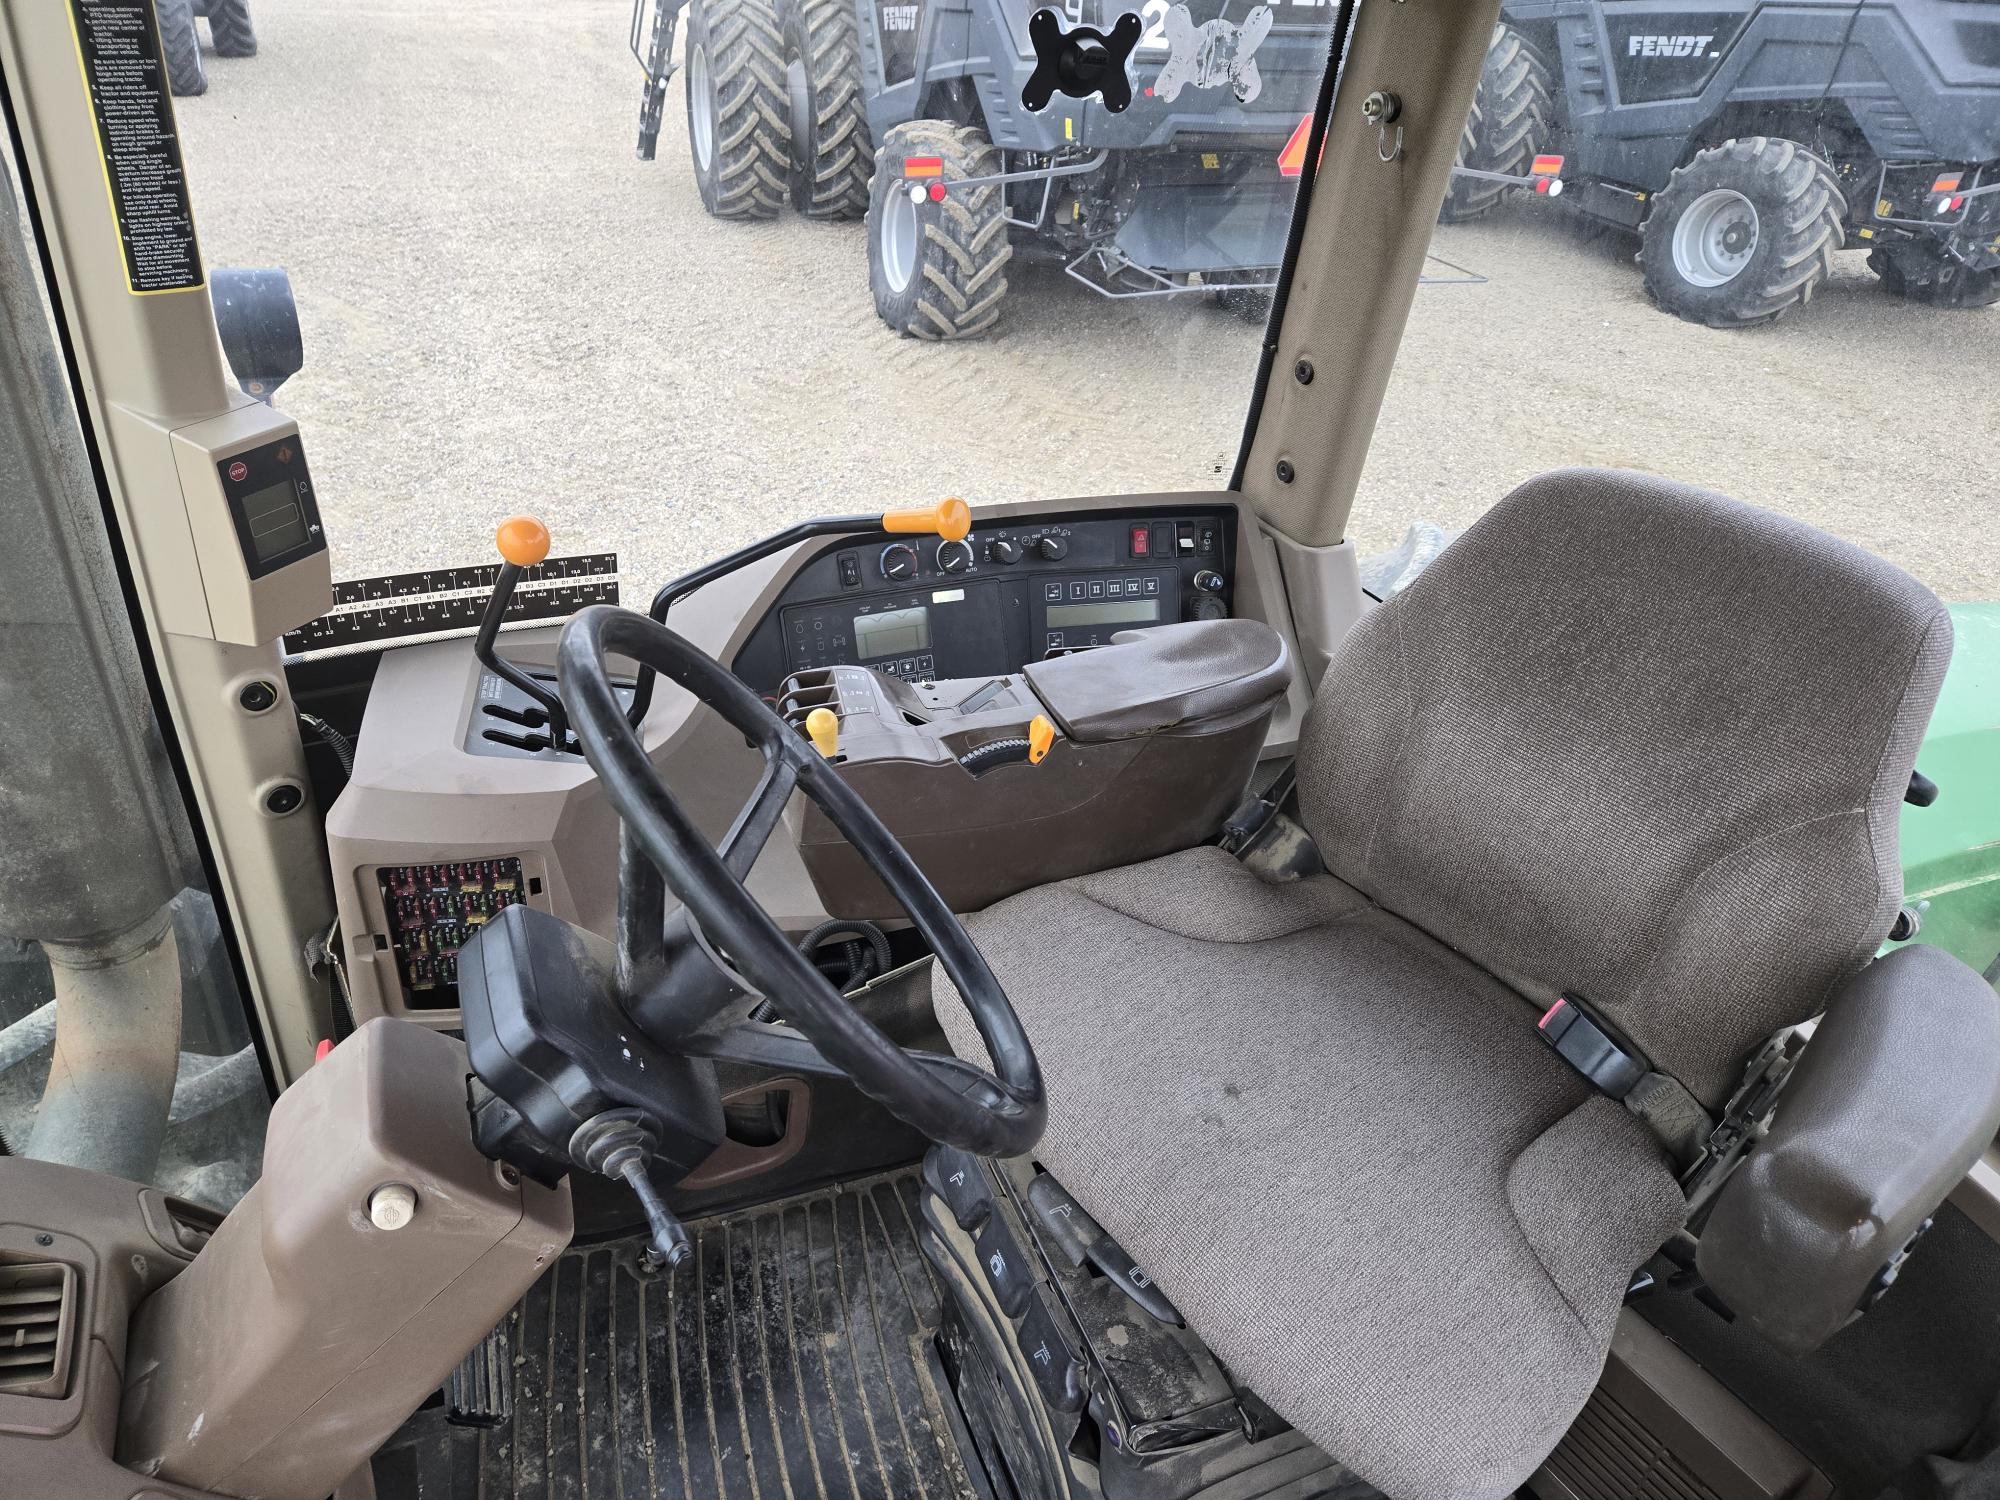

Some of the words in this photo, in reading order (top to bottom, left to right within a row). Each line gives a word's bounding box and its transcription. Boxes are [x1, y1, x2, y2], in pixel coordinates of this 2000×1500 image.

[883, 5, 918, 31] FENDT
[1138, 0, 1170, 49] 2
[1629, 36, 1713, 56] FENDT
[231, 467, 245, 477] STOP
